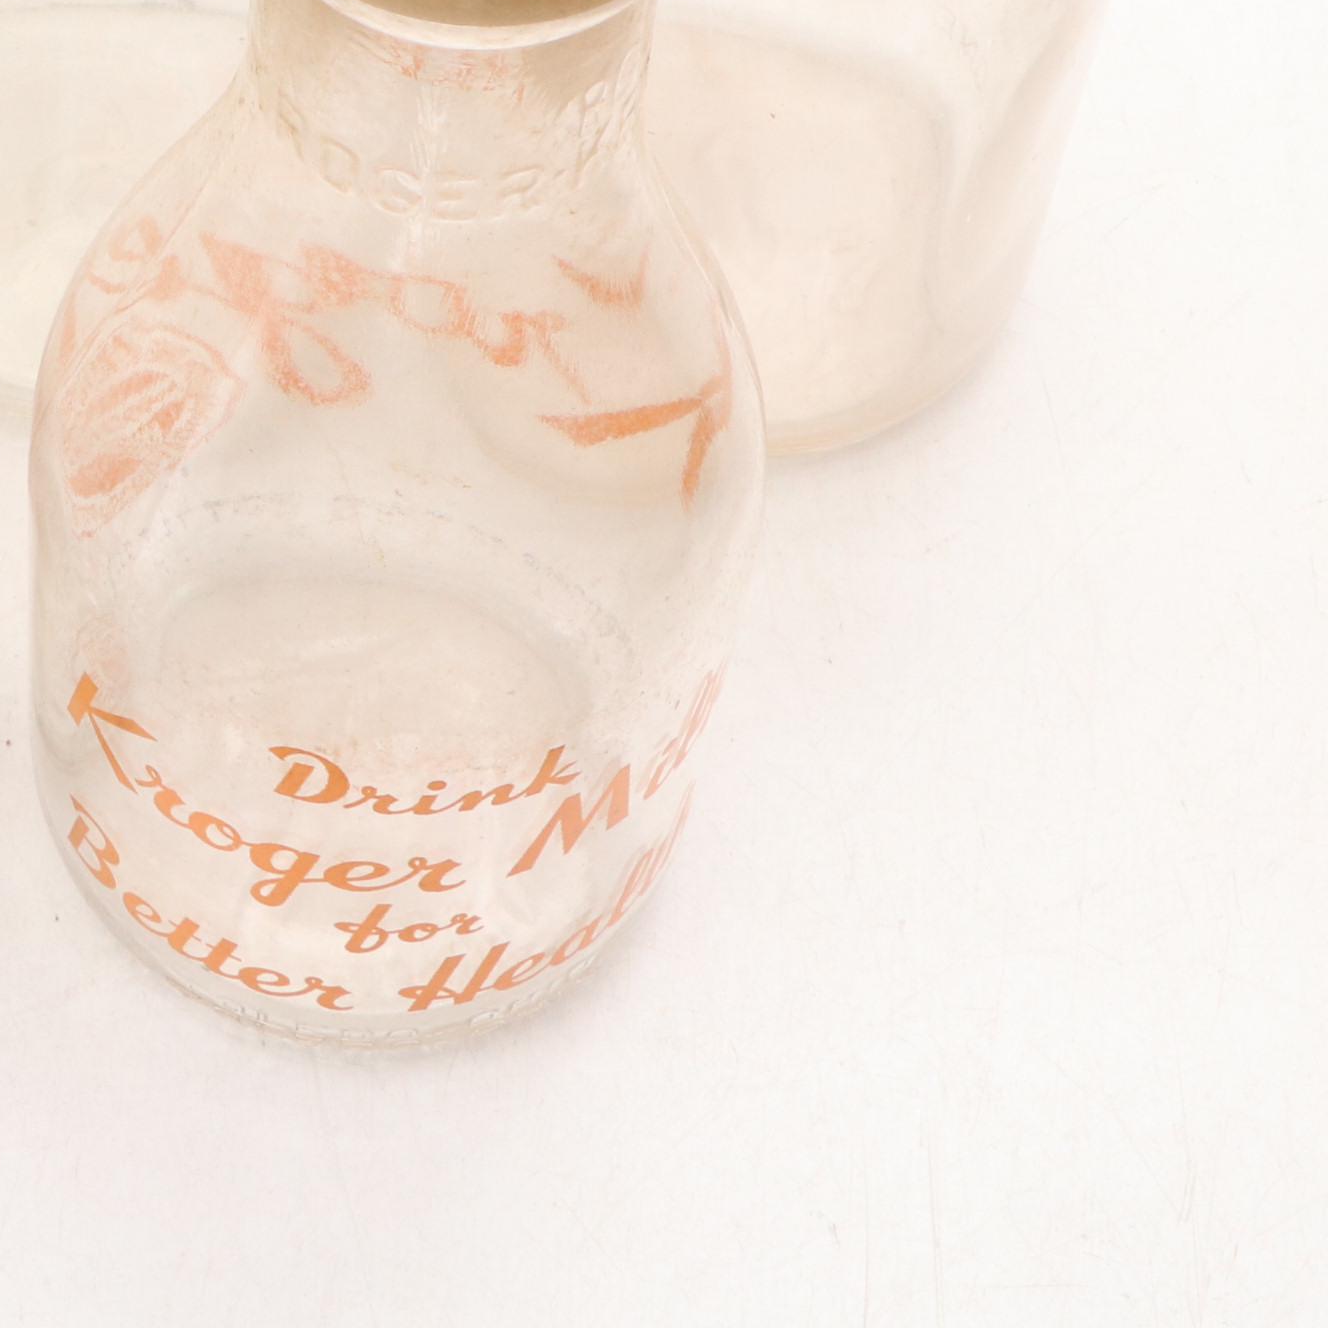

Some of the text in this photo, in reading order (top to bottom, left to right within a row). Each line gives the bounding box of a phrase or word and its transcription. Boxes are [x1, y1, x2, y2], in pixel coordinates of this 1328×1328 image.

[66, 671, 469, 907] Kroger
[268, 743, 581, 816] Drink
[66, 792, 355, 1011] Better
[333, 902, 484, 954] for
